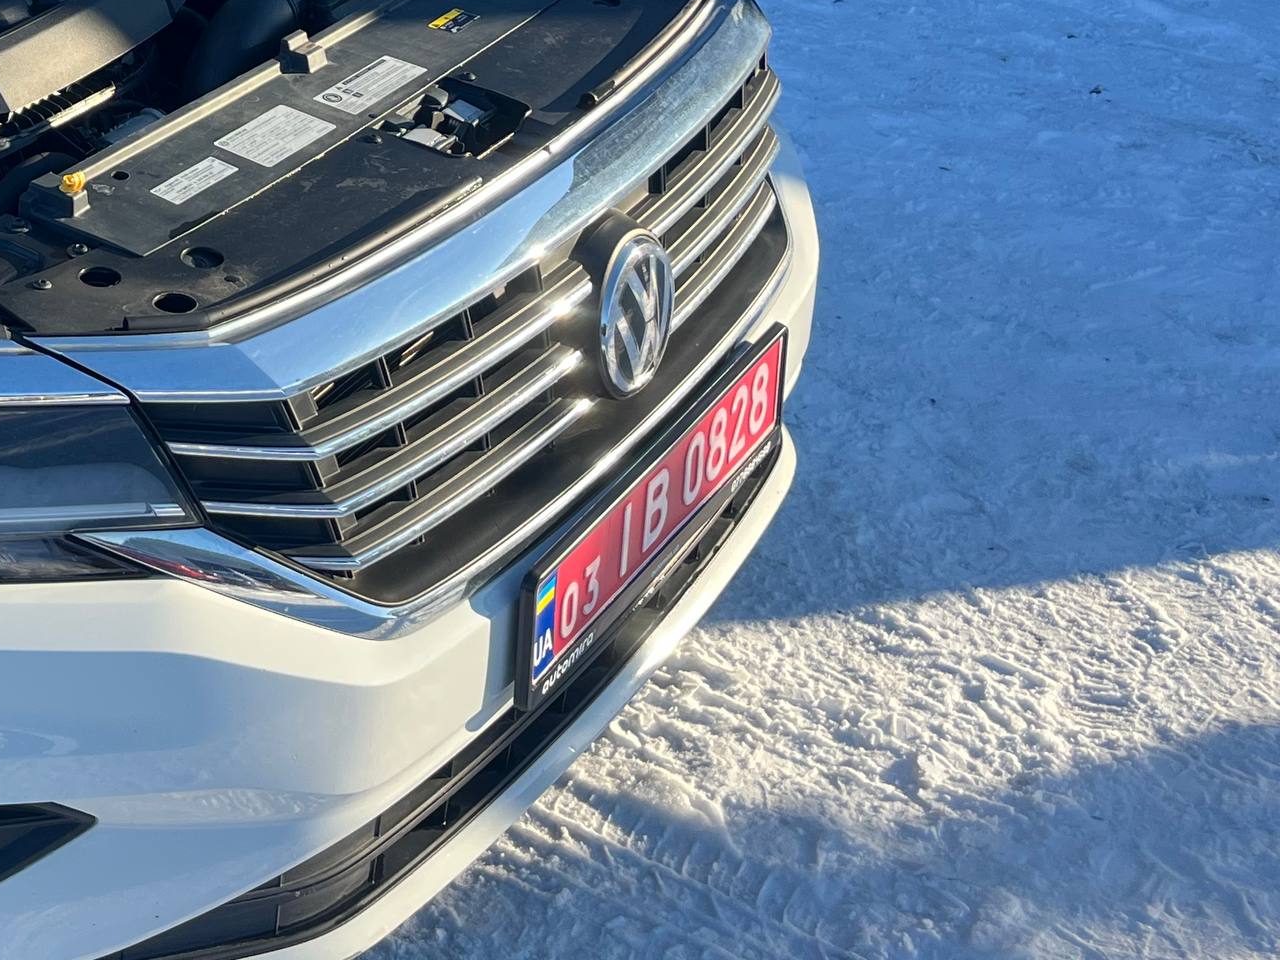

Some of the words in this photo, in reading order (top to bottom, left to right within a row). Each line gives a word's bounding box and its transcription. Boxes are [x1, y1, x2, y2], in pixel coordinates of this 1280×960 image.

[560, 559, 601, 638] 03
[619, 467, 670, 578] IB
[682, 362, 769, 507] 0828
[533, 627, 553, 667] UA
